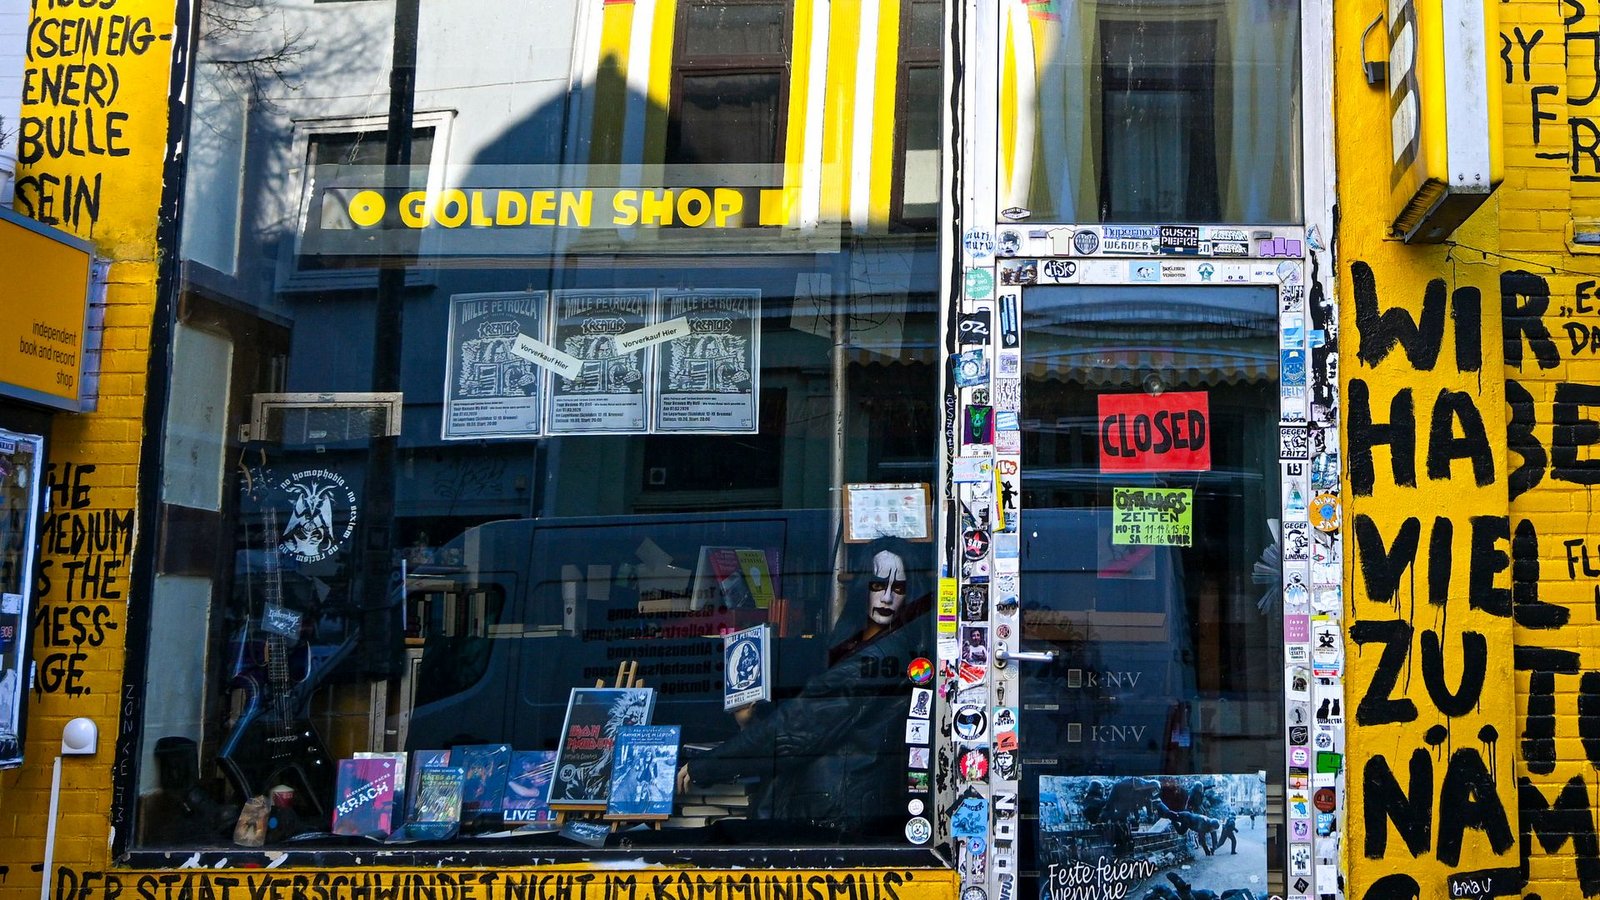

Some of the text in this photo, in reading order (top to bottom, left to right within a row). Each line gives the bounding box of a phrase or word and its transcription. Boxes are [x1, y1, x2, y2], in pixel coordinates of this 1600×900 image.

[23, 62, 119, 107] ENER)
[18, 107, 130, 166] BULLE
[14, 172, 102, 229] SEIN
[399, 188, 744, 228] GOLDEN SHOP
[1161, 228, 1198, 237] GUSCH
[1161, 237, 1198, 246] PIEFKE
[462, 299, 537, 325] MILLE PETROZZA
[565, 296, 644, 320] MILLE PETROZZA
[670, 296, 750, 319] MILLE PETROZZA
[1350, 260, 1560, 373] WIR
[32, 318, 77, 347] independent
[477, 319, 521, 339] KREATOR
[580, 317, 627, 335] KREATOR
[622, 327, 677, 348] Vorverkauf Hier
[689, 317, 734, 335] KREATOR
[19, 335, 76, 367] book and record
[520, 343, 569, 370] Vorverkauf Hier
[56, 370, 74, 390] shop
[1101, 409, 1206, 458] CLOSED
[280, 468, 345, 490] no homophobia
[1289, 463, 1301, 474] 13
[346, 491, 356, 503] no
[1121, 512, 1179, 523] ZEITEN
[327, 544, 339, 555] no
[1129, 534, 1141, 543] SA
[1166, 534, 1191, 544] UHR
[62, 555, 122, 603] THE
[1352, 513, 1571, 630] VIEL
[1349, 619, 1487, 728] ZU
[337, 781, 389, 817] KRACH
[503, 809, 537, 821] LIVE
[56, 866, 124, 900] DER
[135, 874, 241, 900] STAAT
[247, 872, 500, 900] VERSCHWINDET
[504, 873, 596, 900] NICHT
[604, 873, 637, 900] IM
[1047, 855, 1156, 887] Feste feiern
[1050, 878, 1127, 900] wenn sie
